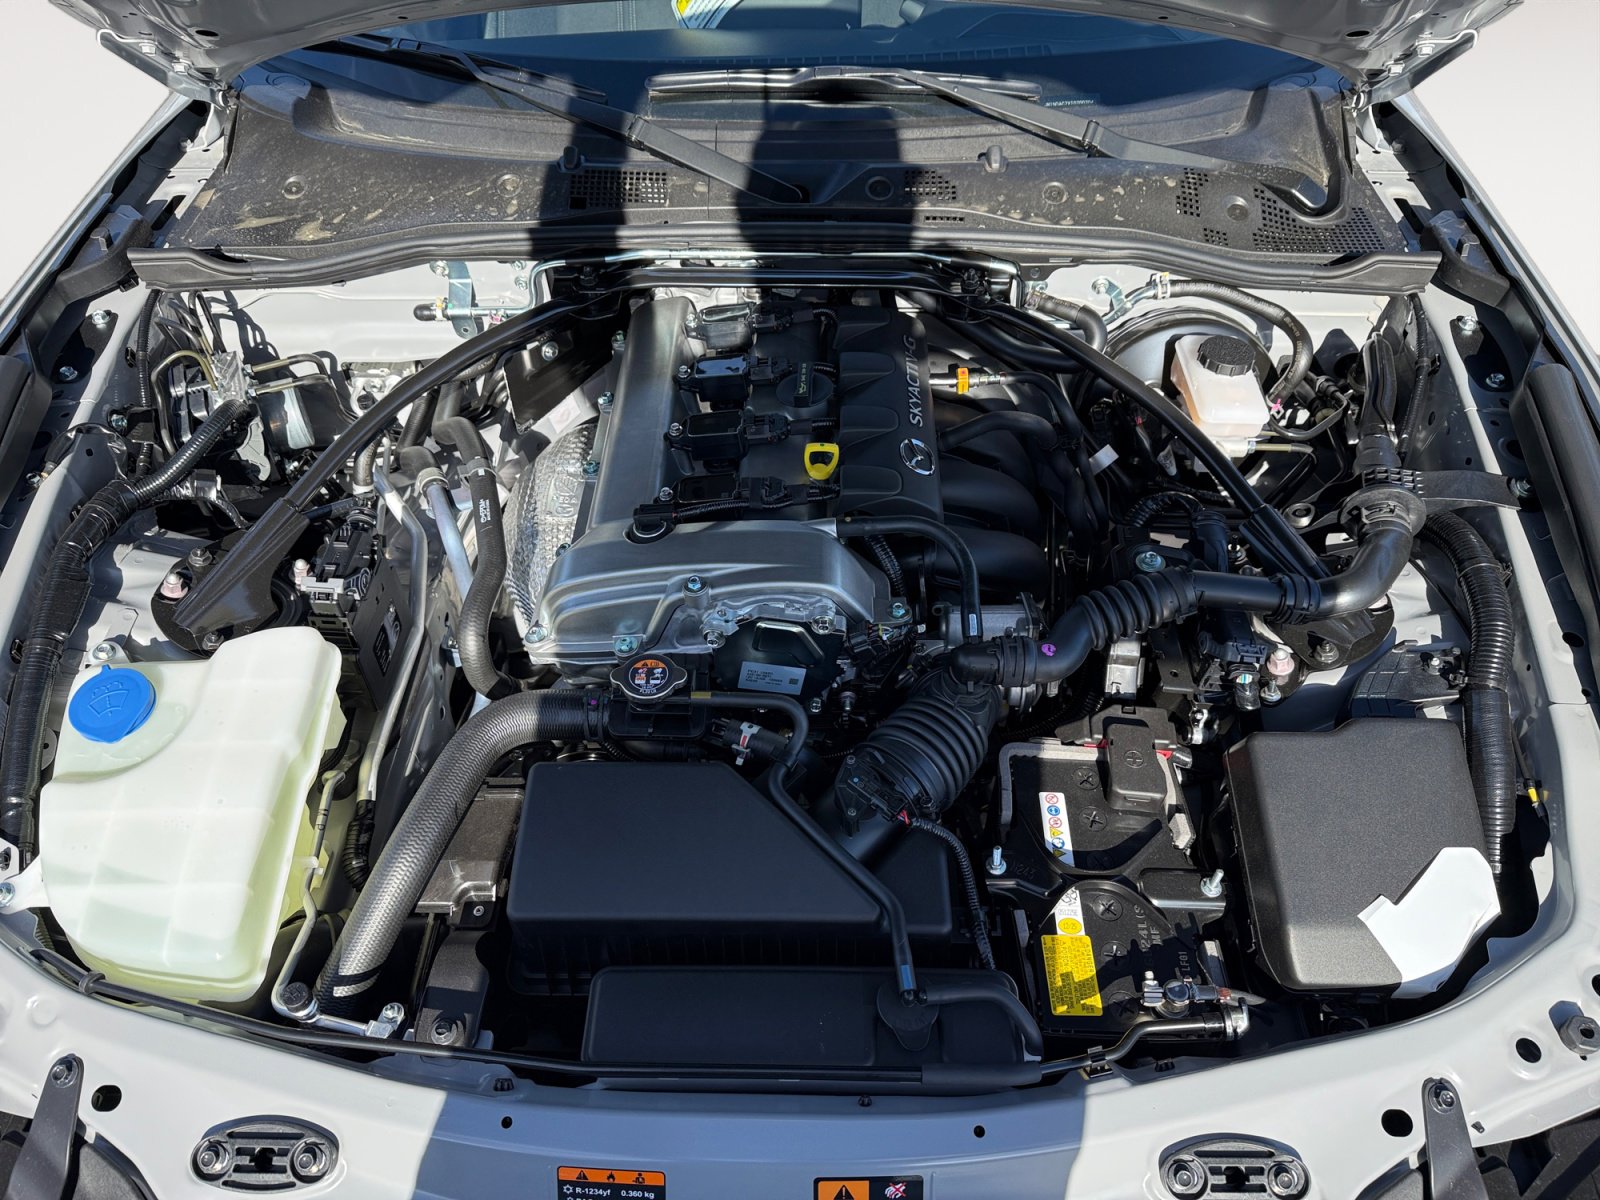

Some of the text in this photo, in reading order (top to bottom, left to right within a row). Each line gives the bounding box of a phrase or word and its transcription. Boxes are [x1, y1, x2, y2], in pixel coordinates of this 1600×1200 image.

[904, 334, 923, 427] SKYACTIV-G
[575, 1187, 611, 1196] R-1234yf
[644, 1191, 655, 1199] kg
